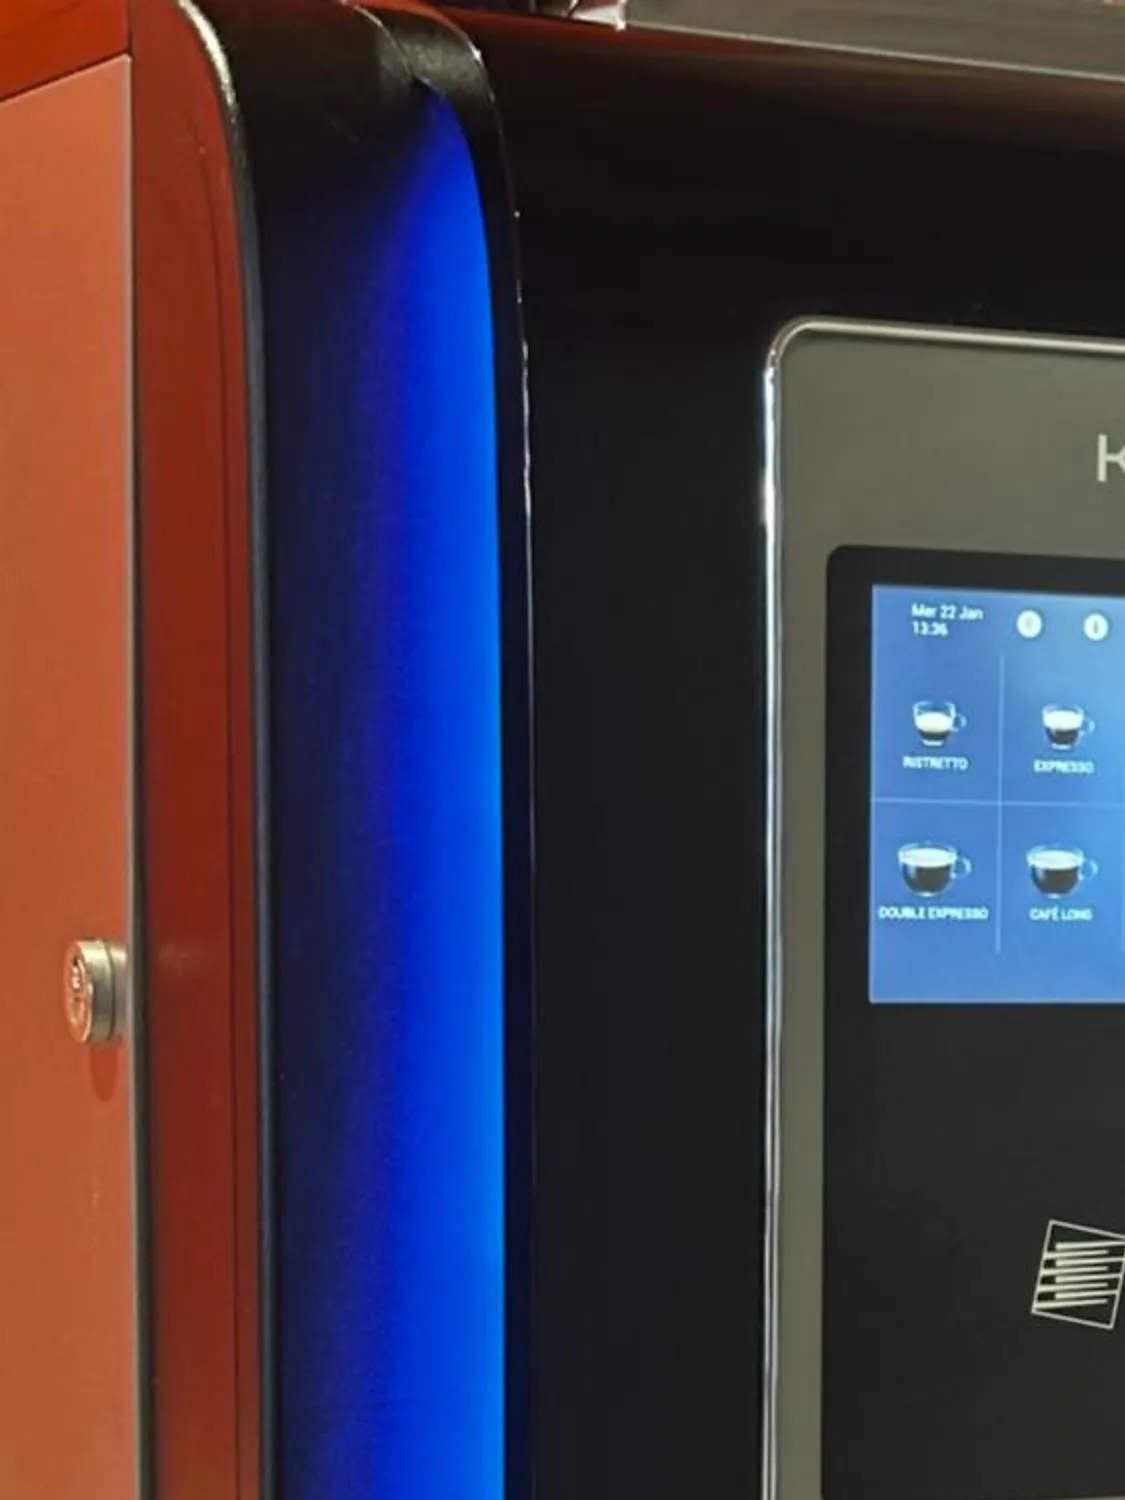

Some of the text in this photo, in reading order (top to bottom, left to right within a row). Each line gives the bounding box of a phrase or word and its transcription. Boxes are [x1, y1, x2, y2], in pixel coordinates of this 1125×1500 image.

[912, 603, 984, 620] Mer 22 Jan
[902, 756, 968, 770] RISTRETTO
[1034, 759, 1095, 774] EXPRESSO
[878, 906, 989, 920] DOUBLE EXPRESSO
[1029, 906, 1093, 921] CAFÉ LONG
